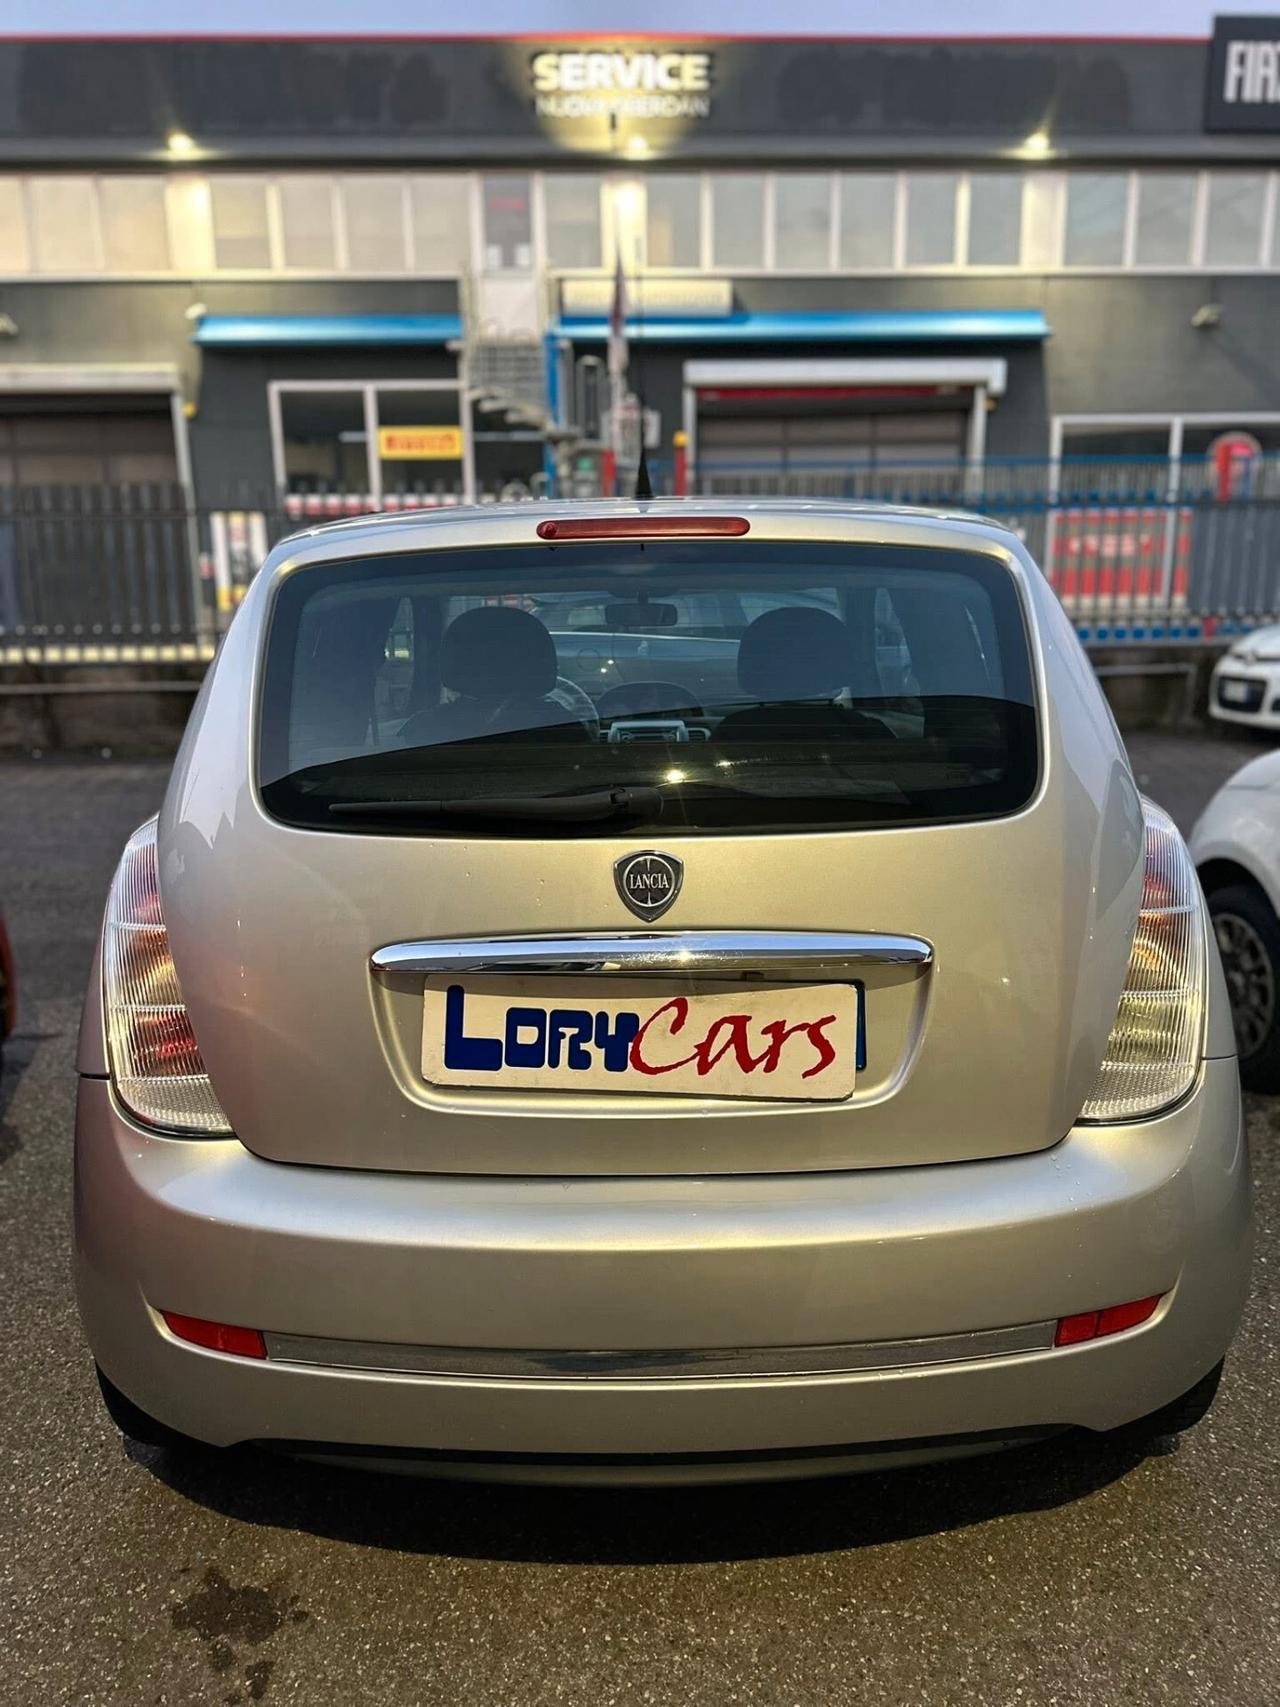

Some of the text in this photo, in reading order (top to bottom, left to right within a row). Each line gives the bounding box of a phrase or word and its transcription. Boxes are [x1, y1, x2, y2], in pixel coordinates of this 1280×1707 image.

[533, 53, 710, 91] SERVICE
[1223, 41, 1280, 103] FIA
[630, 873, 670, 889] LANCIA
